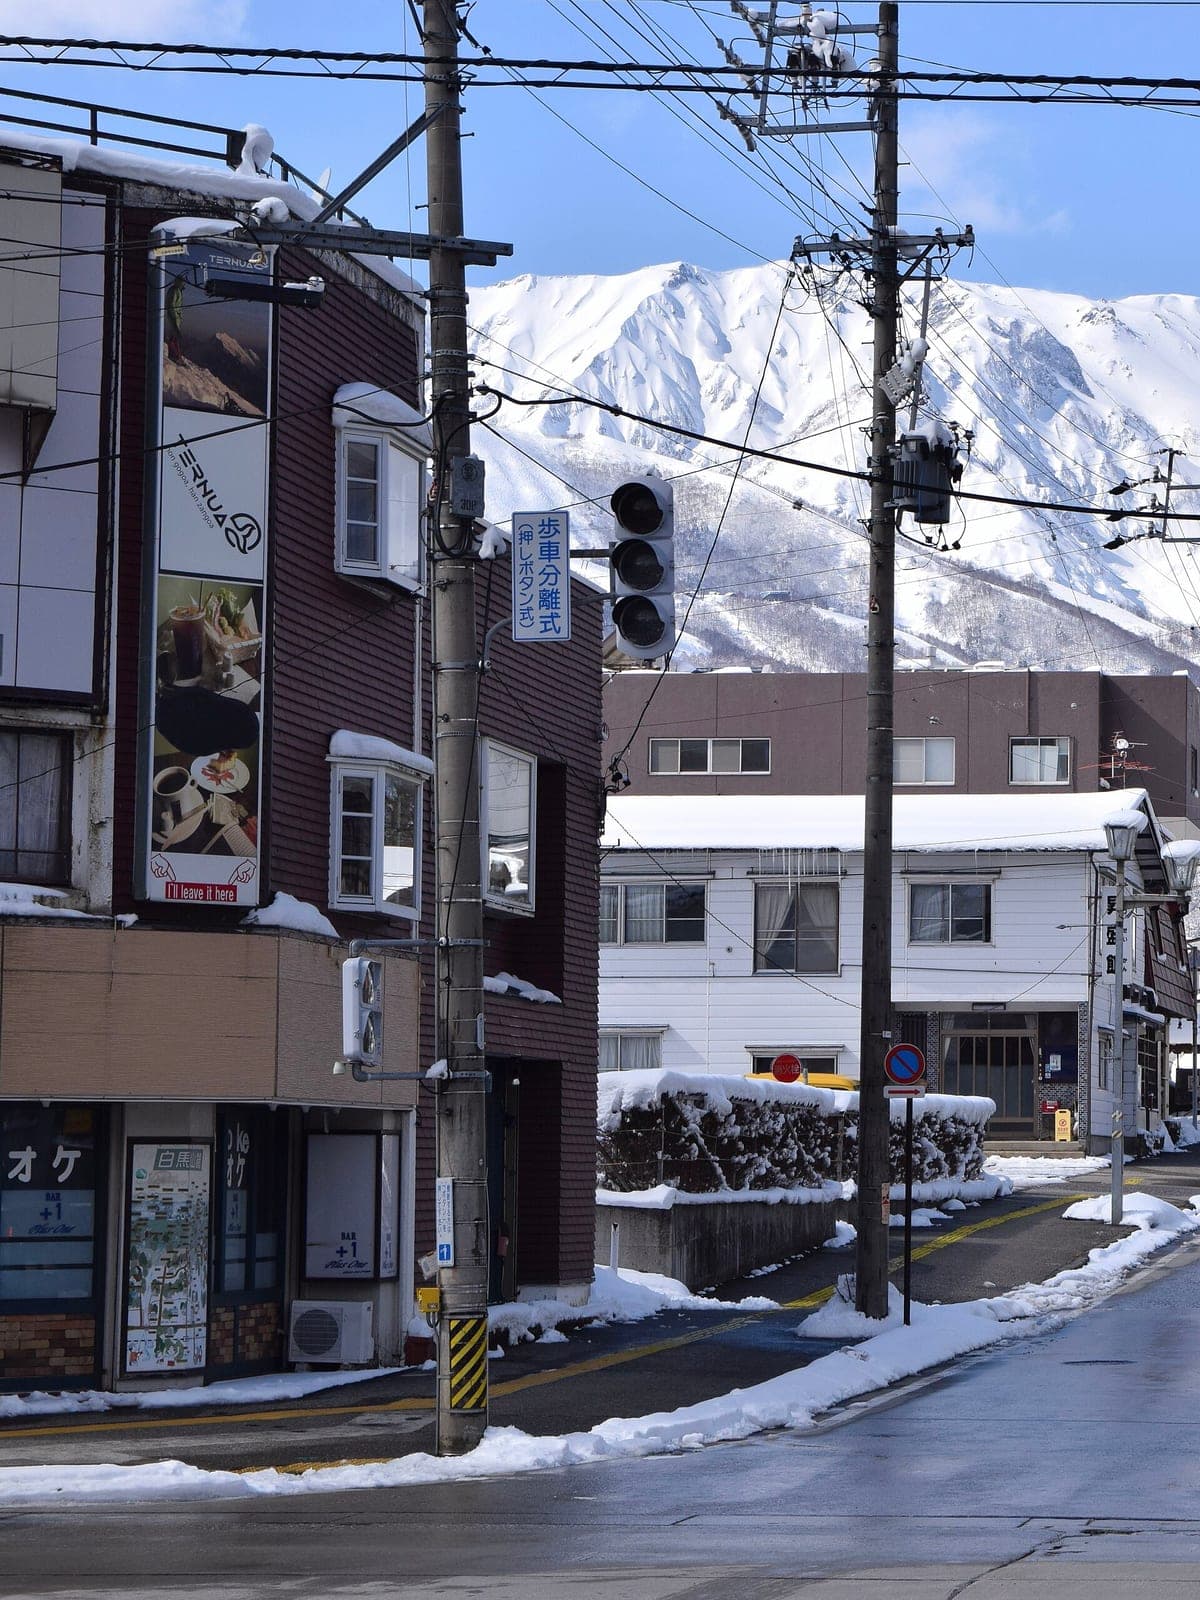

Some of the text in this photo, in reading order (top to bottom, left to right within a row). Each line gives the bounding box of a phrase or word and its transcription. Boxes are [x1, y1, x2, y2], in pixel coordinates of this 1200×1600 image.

[209, 254, 253, 268] TERNUA
[179, 433, 227, 528] TERNUA
[538, 517, 561, 635] 歩車分離式
[167, 883, 234, 901] I'll leave it here
[8, 1145, 81, 1183] オケ
[40, 1203, 62, 1220] +1
[341, 1232, 357, 1241] BAR
[336, 1242, 358, 1258] +1
